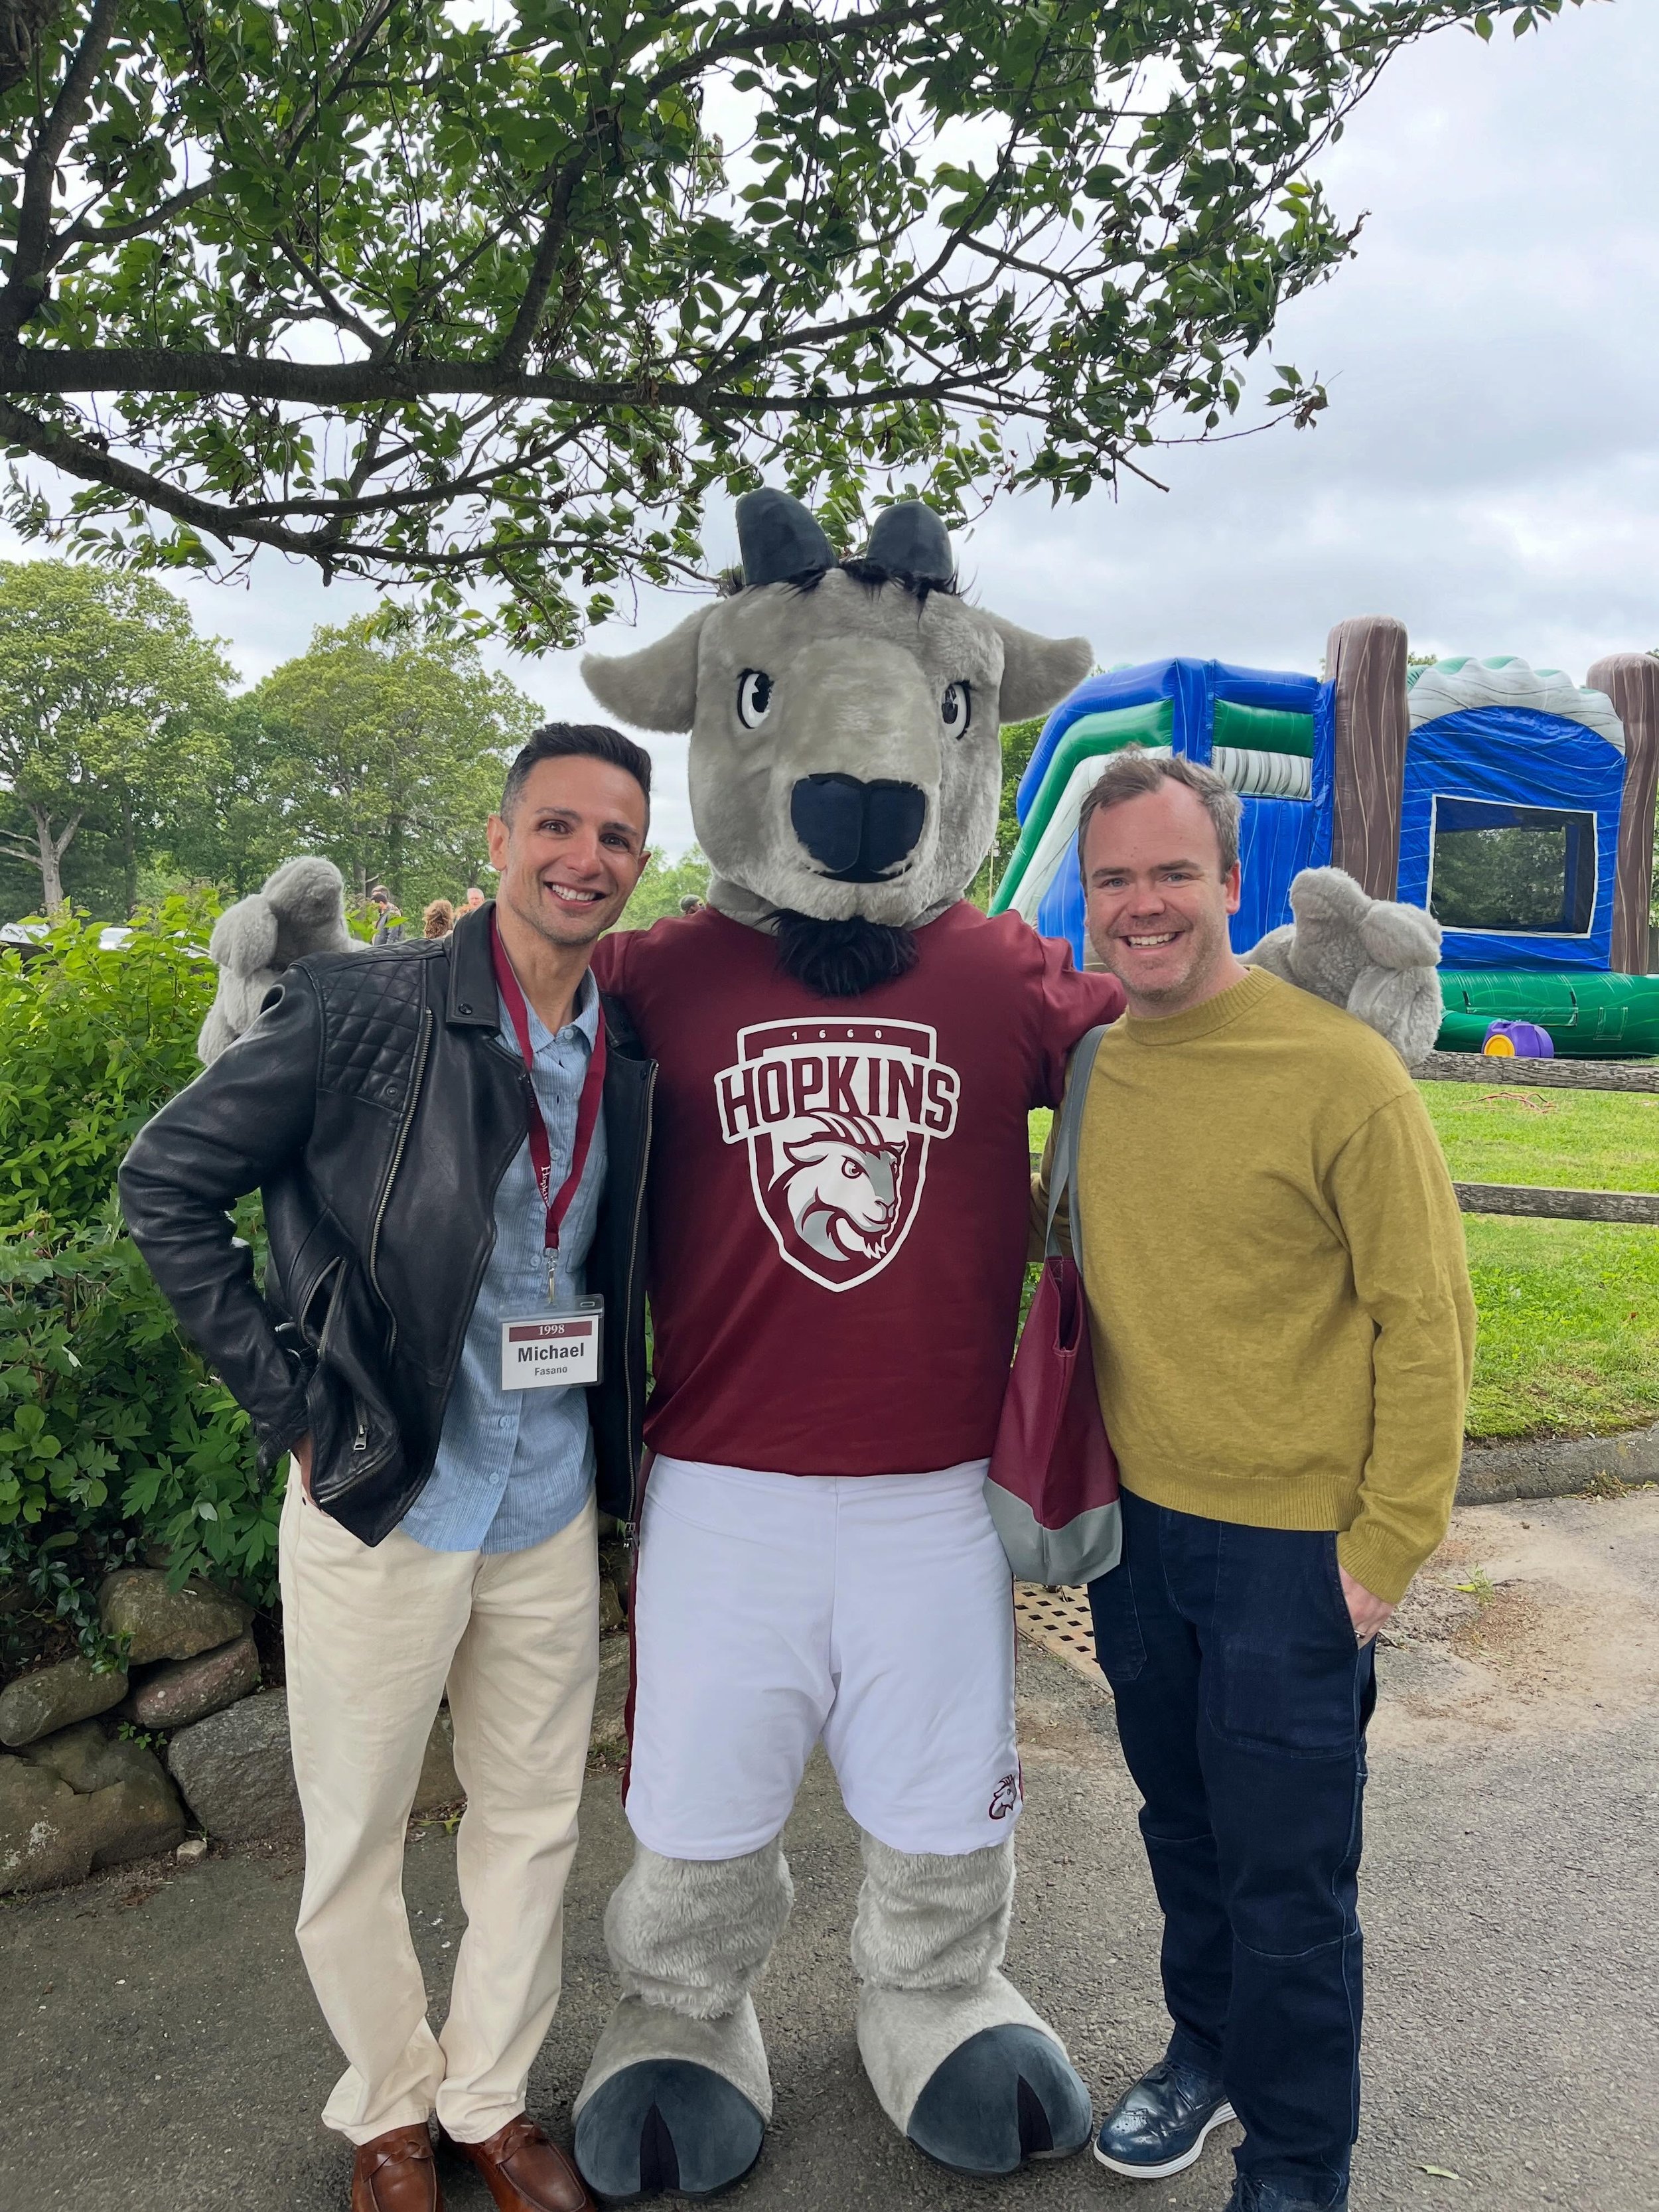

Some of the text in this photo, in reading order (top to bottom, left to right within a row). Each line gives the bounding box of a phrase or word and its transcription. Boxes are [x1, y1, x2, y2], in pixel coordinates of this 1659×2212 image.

[791, 1029, 883, 1041] 1660
[721, 1056, 955, 1138] HOPKINS
[538, 1324, 565, 1335] 1998
[518, 1342, 585, 1363] Michael
[534, 1366, 568, 1376] Fasano
